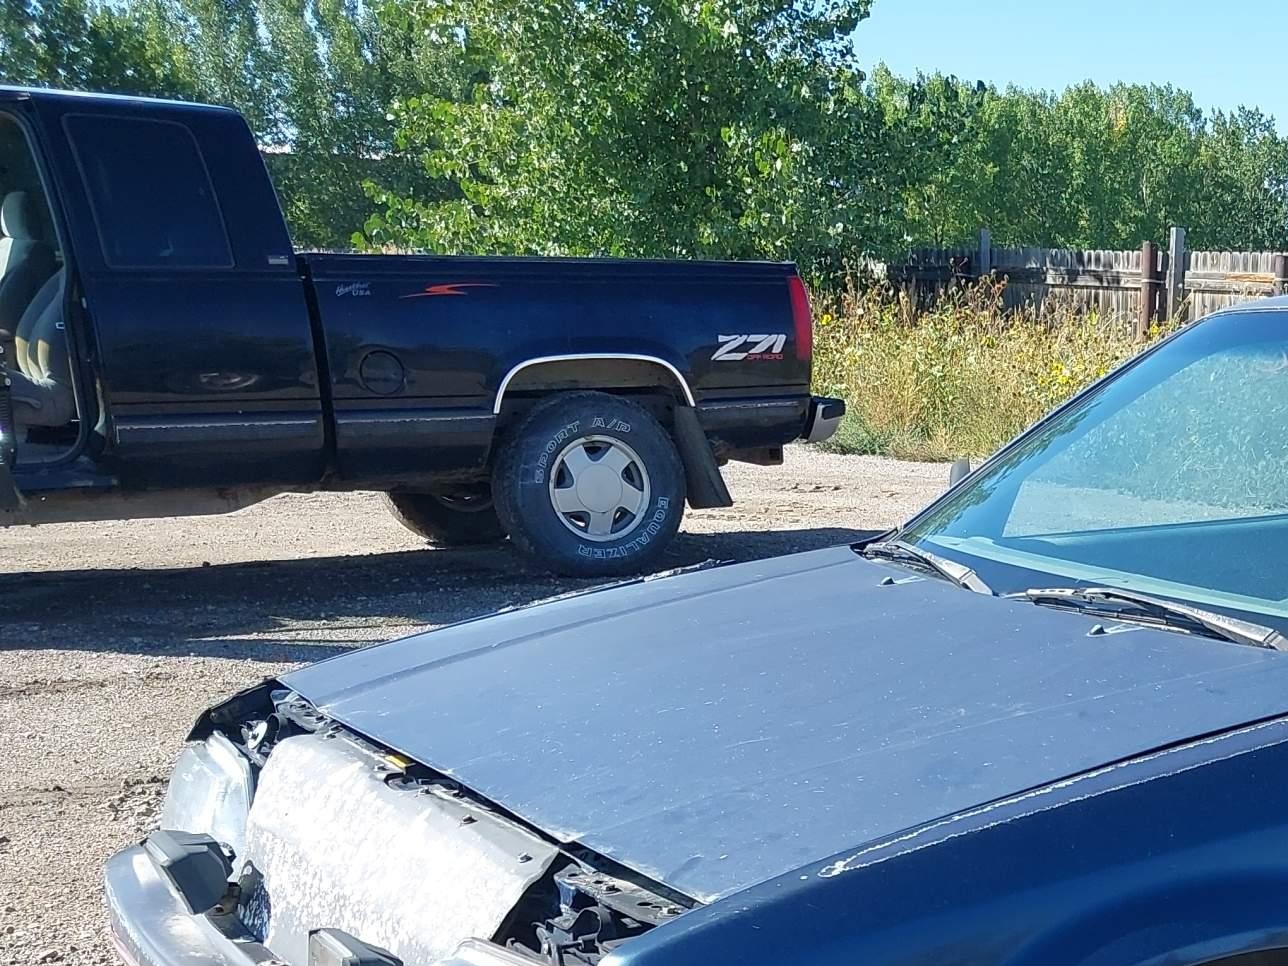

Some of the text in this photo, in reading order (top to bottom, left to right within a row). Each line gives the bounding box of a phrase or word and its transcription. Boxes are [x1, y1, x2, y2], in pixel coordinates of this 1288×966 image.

[710, 334, 787, 361] Z71
[535, 416, 632, 484] SPORT A/P
[577, 496, 669, 559] EQUALIZER
